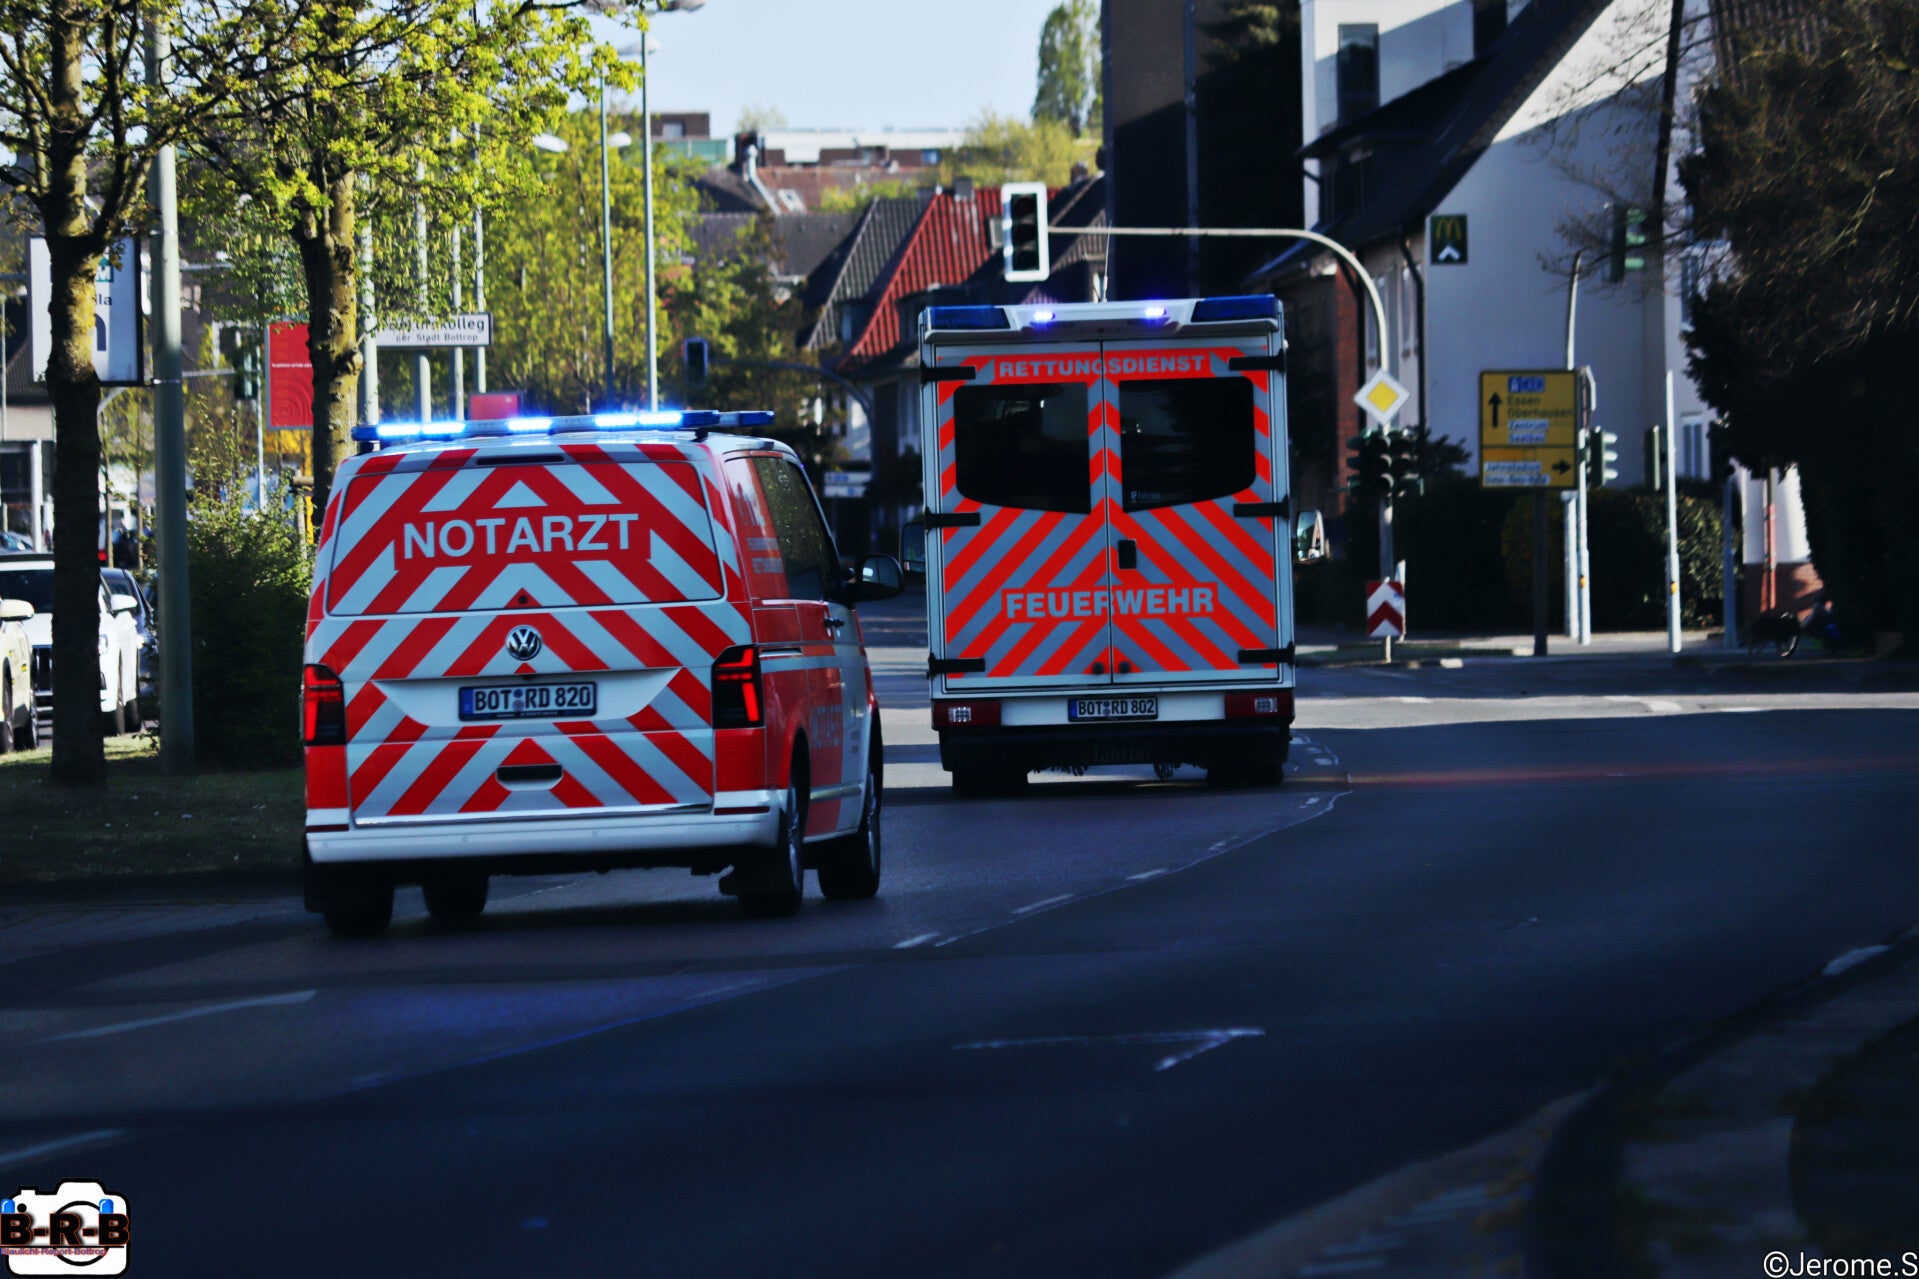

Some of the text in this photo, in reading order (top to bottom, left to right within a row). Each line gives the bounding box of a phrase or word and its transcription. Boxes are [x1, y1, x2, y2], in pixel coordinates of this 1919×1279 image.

[1000, 355, 1205, 378] RETTUNGSDIENST
[404, 513, 639, 560] NOTARZT
[1006, 587, 1214, 619] FEUERWEHR
[474, 686, 591, 712] BOT RD 820
[1078, 699, 1155, 715] BOT RD 802
